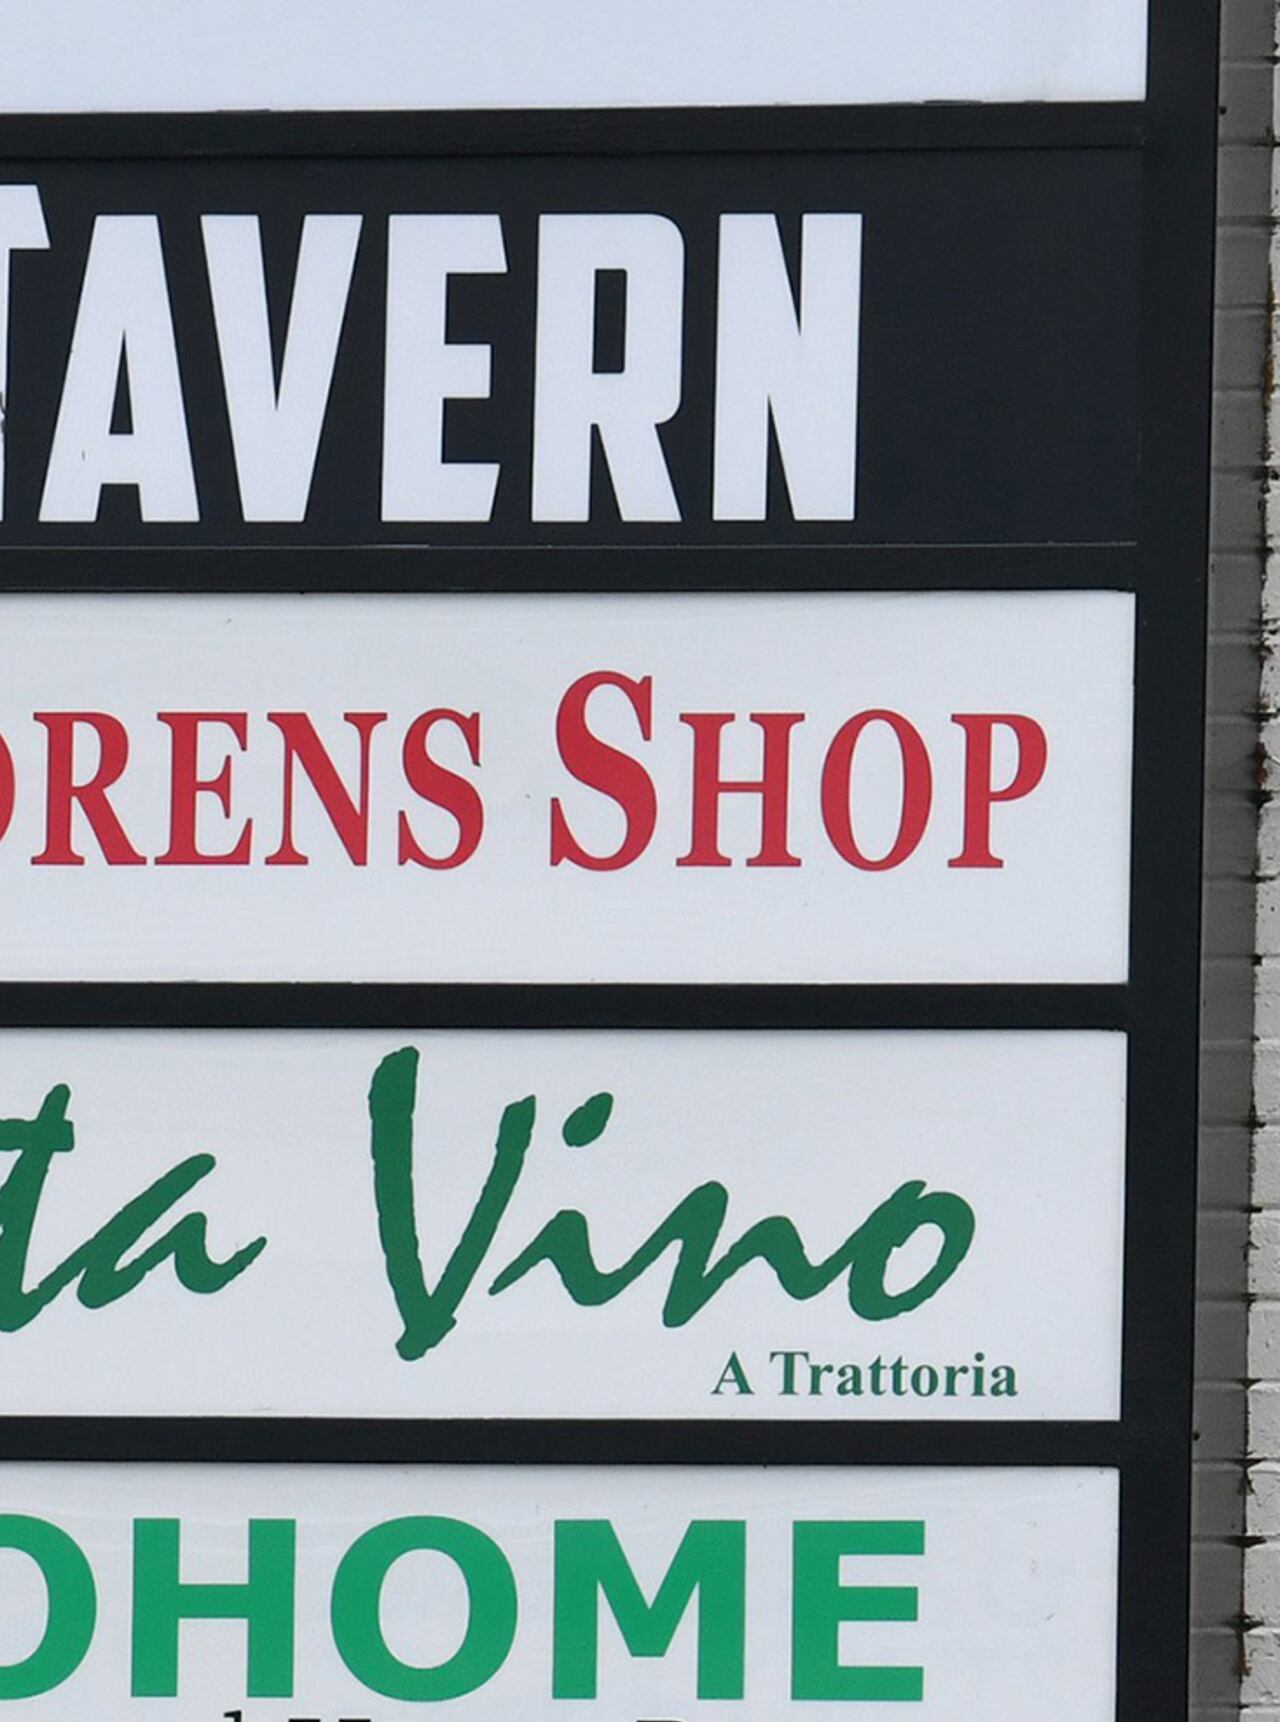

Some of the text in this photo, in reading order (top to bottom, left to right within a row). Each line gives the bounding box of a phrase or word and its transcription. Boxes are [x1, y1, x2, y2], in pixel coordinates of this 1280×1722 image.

[550, 671, 1047, 871] SHOP
[366, 1045, 978, 1362] Vino
[712, 1352, 1017, 1396] A Trattoria
